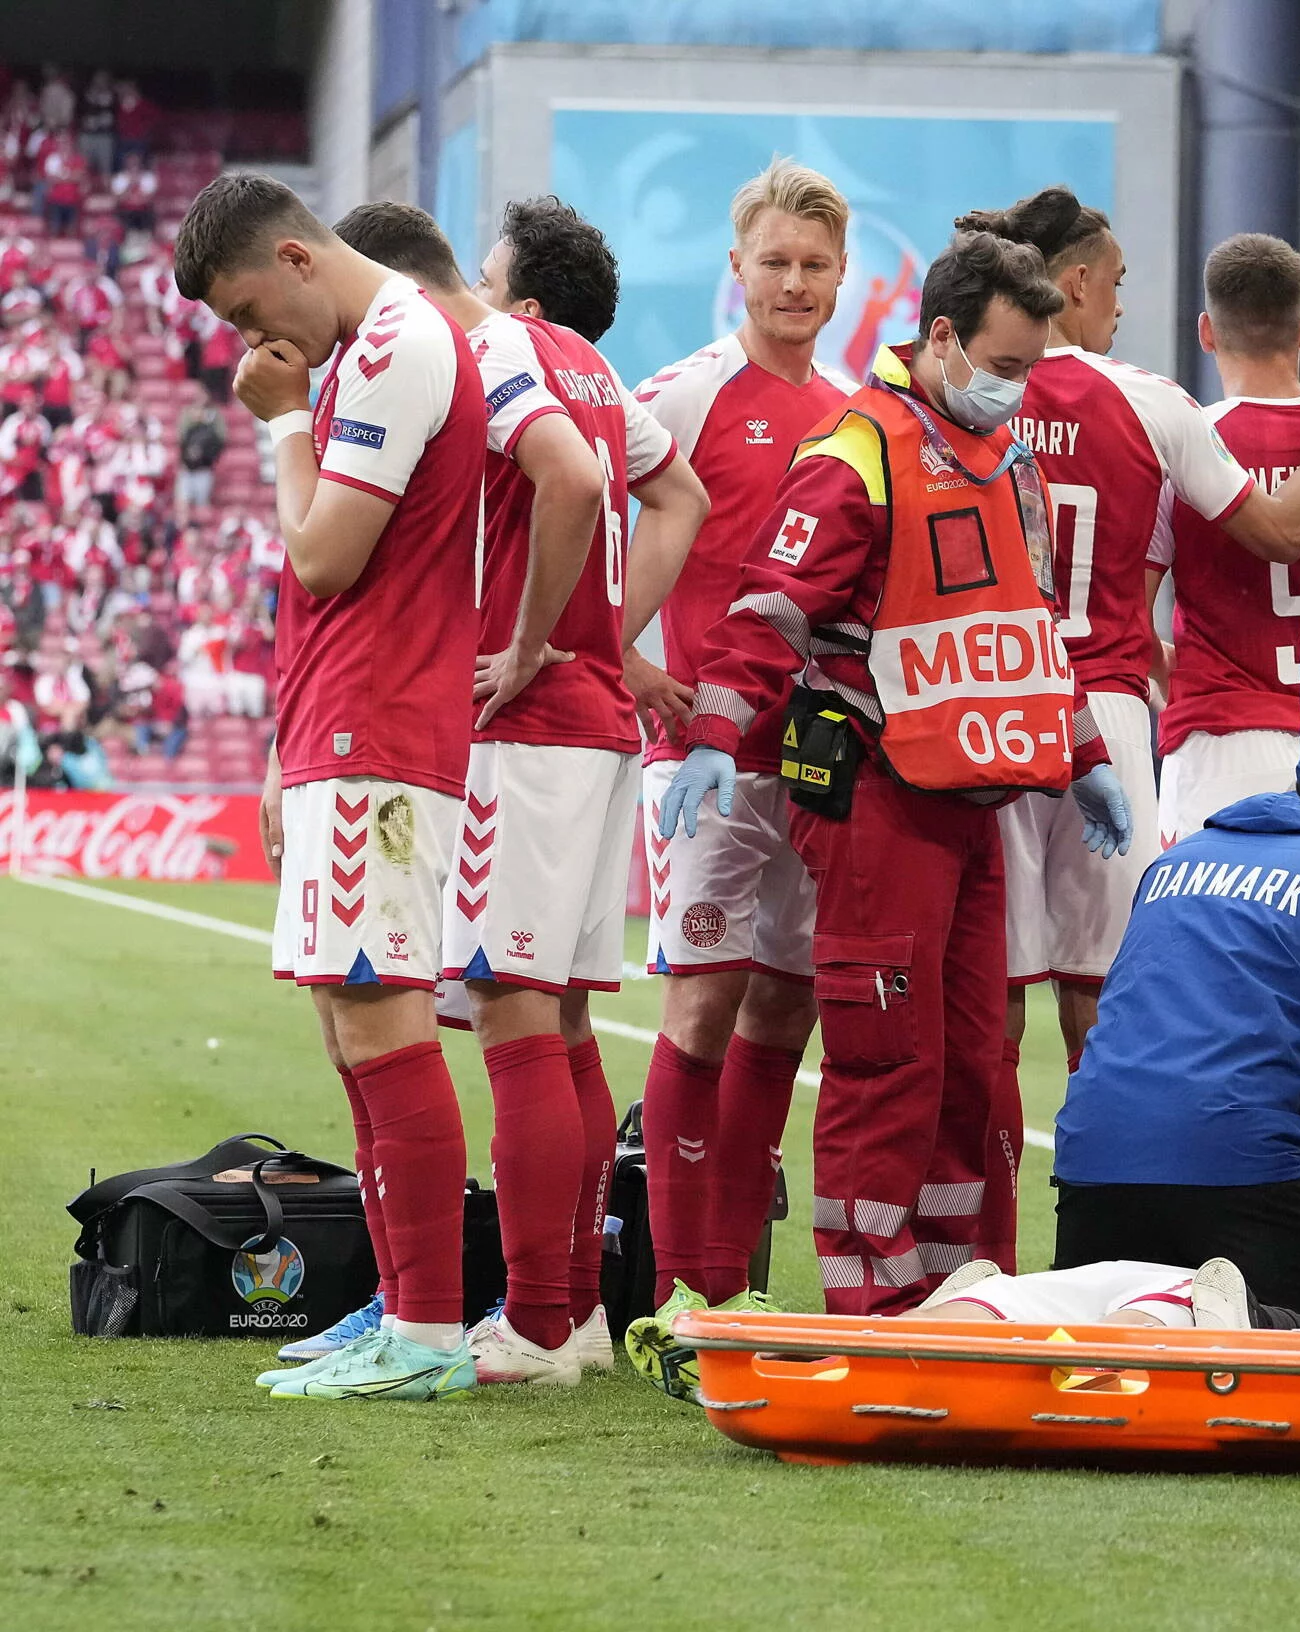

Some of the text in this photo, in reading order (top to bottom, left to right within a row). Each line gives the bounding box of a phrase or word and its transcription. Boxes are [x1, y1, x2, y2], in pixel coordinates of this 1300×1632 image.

[492, 375, 533, 406] RESPECT
[341, 426, 384, 443] RESPECT
[926, 477, 969, 493] EURO2020
[595, 436, 623, 607] 6
[805, 767, 827, 783] PAX
[302, 879, 319, 956] 9
[691, 917, 718, 932] DBU
[386, 951, 409, 961] hummel
[506, 949, 535, 961] hummel
[593, 1160, 610, 1235] DANMARK
[253, 1302, 280, 1314] UEFA
[229, 1313, 309, 1329] EURO2020
